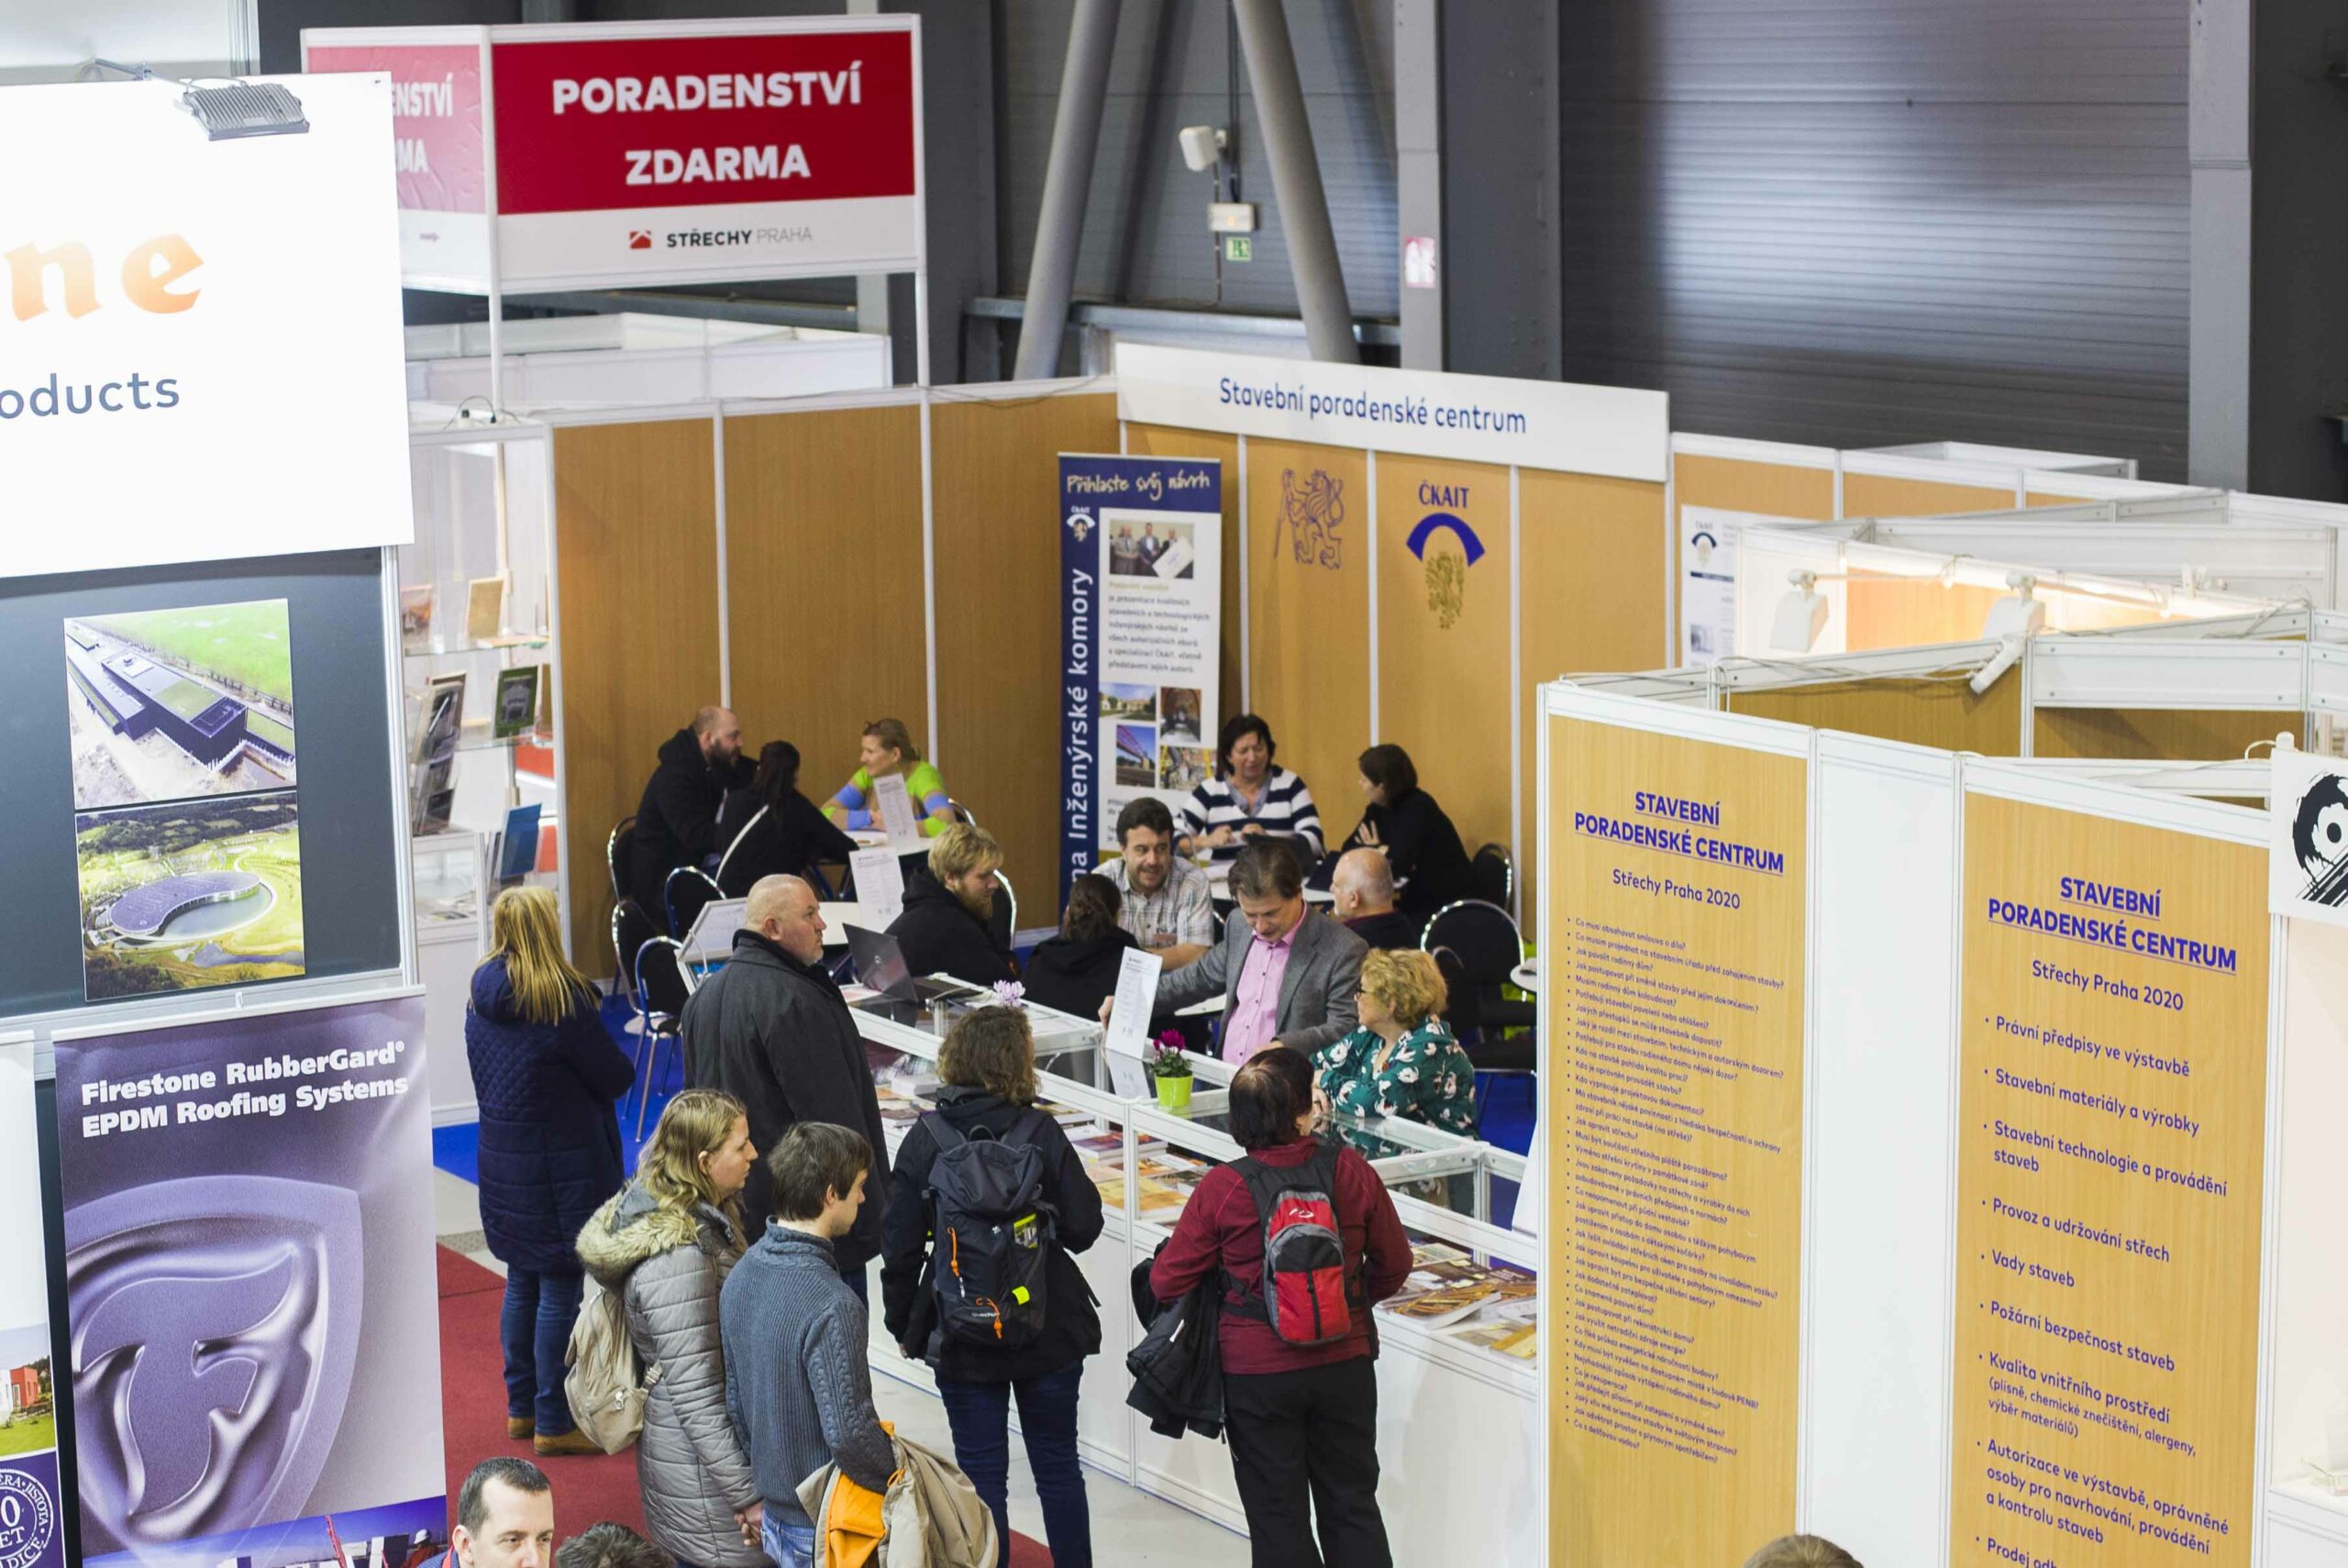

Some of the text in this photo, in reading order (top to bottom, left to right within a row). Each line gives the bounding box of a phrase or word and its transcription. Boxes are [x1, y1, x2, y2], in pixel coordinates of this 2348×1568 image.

[553, 61, 862, 115] PORADENSTVÍ
[396, 138, 428, 173] MA
[626, 144, 811, 186] ZDARMA
[667, 226, 814, 248] STŘECHY PRAHA
[1219, 378, 1527, 434] Stavební poradenské centrum
[1067, 472, 1130, 494] Přihlaste
[1168, 469, 1211, 490] návrh
[1418, 479, 1469, 509] ČKAIT
[1068, 569, 1093, 676] komory
[1066, 687, 1093, 840] Inženýrské
[1635, 791, 1720, 825] STAVEBNÍ
[1575, 812, 1783, 872] PORADENSKÉ CENTRUM
[1612, 868, 1740, 909] Střechy Praha 2020
[2060, 877, 2161, 916] STAVEBNÍ
[1988, 899, 2236, 970] PORADENSKÉ CENTRUM
[2032, 960, 2183, 1010] Střechy Praha 2020
[1996, 1015, 2189, 1076] Právní předpisy ve výstavbě
[82, 1068, 216, 1106] Firestone
[83, 1074, 409, 1138] EPDM Roofing Systems
[1996, 1068, 2199, 1137] Stavební materiály a výrobky
[1994, 1150, 2039, 1171] staveb
[1995, 1120, 2227, 1196] Stavební technologie a provádění
[1993, 1198, 2168, 1261] Provoz a udržování střech
[1992, 1249, 2075, 1286] Vady staveb
[1990, 1300, 2174, 1371] Požární bezpečnost staveb
[1989, 1352, 2169, 1422] Kvalita vnitřního prostředí
[1988, 1376, 2195, 1456] (plísně, chemické znečištění, alergeny,
[1988, 1398, 2078, 1438] výběr materiálů)
[1987, 1468, 2210, 1553] osoby pro navrhování, provádění
[1988, 1439, 2228, 1534] Autorizace ve výstavbě, oprávněné
[1987, 1493, 2103, 1543] a kontrolu staveb
[0, 1536, 44, 1568] DICE
[1988, 1537, 2031, 1568] Prodej
